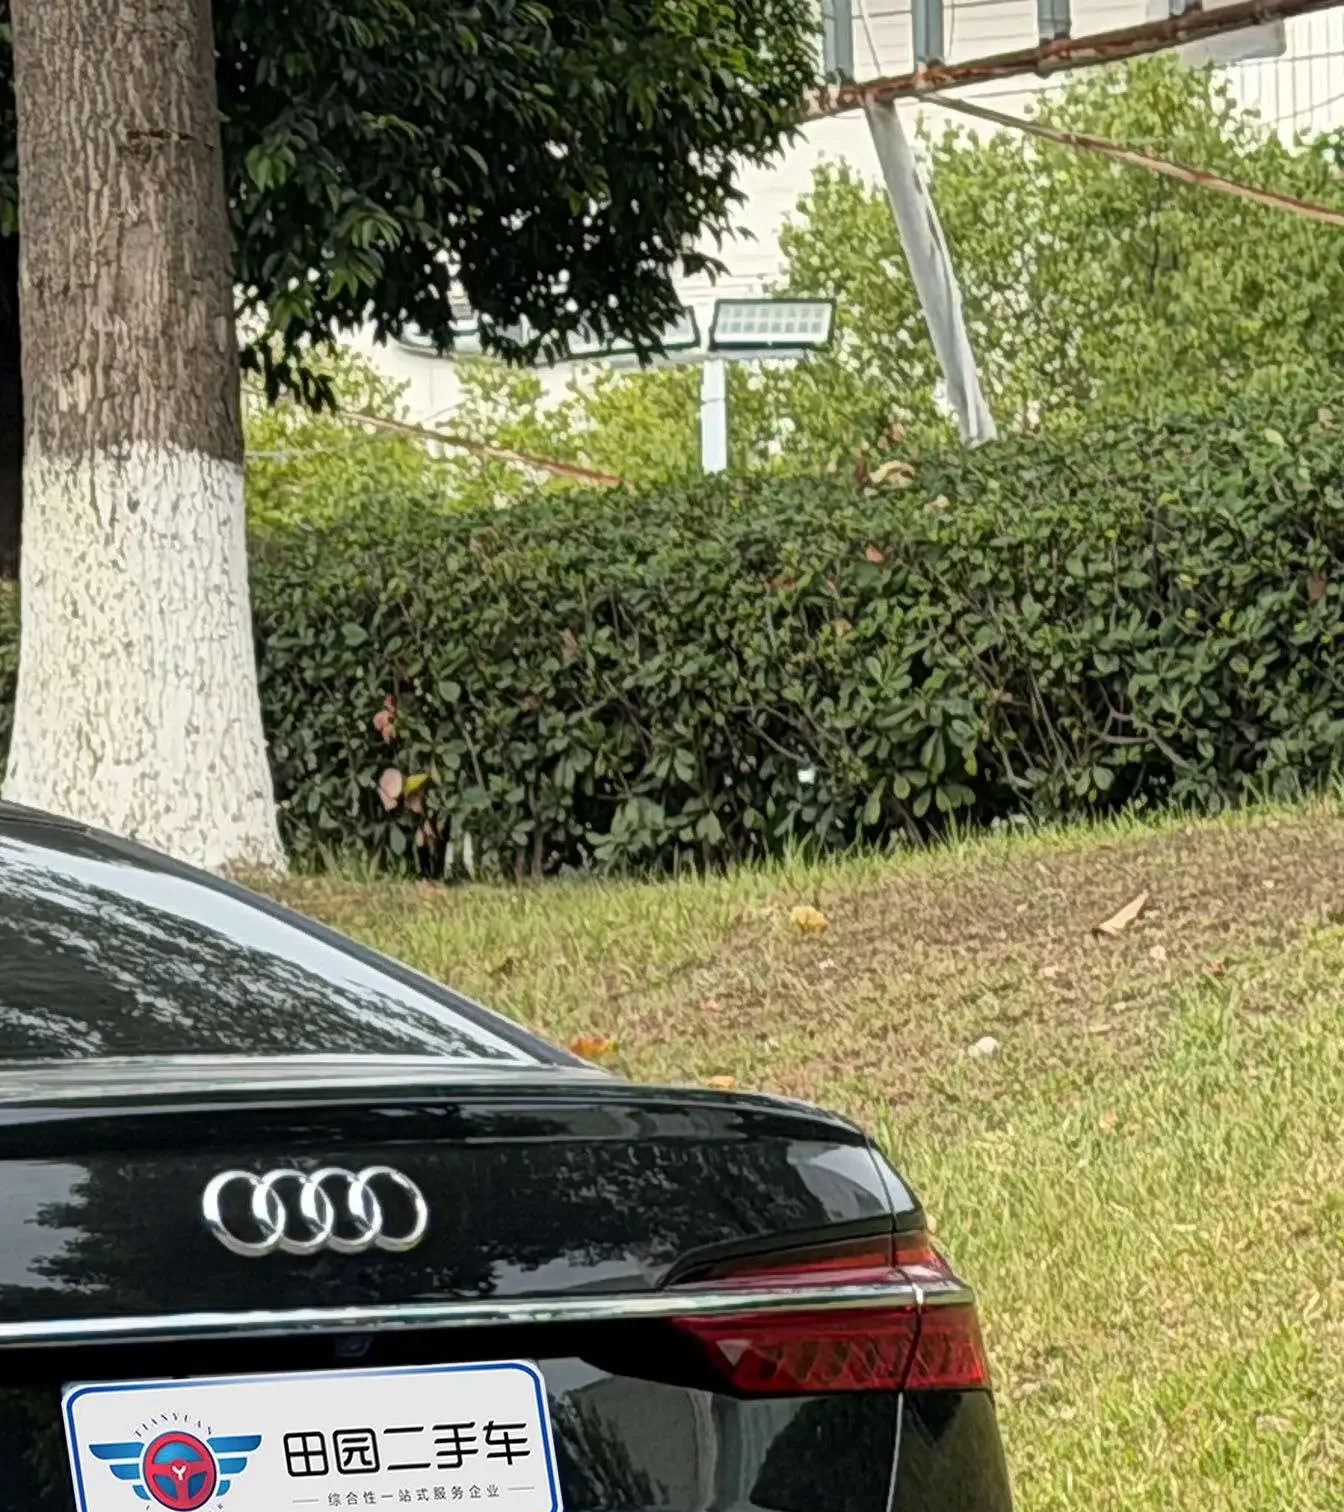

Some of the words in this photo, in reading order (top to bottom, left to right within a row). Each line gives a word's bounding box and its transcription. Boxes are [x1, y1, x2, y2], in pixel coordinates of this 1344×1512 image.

[282, 1420, 531, 1478] 田园二手车
[327, 1483, 501, 1507] 综合性一站式服务企业
